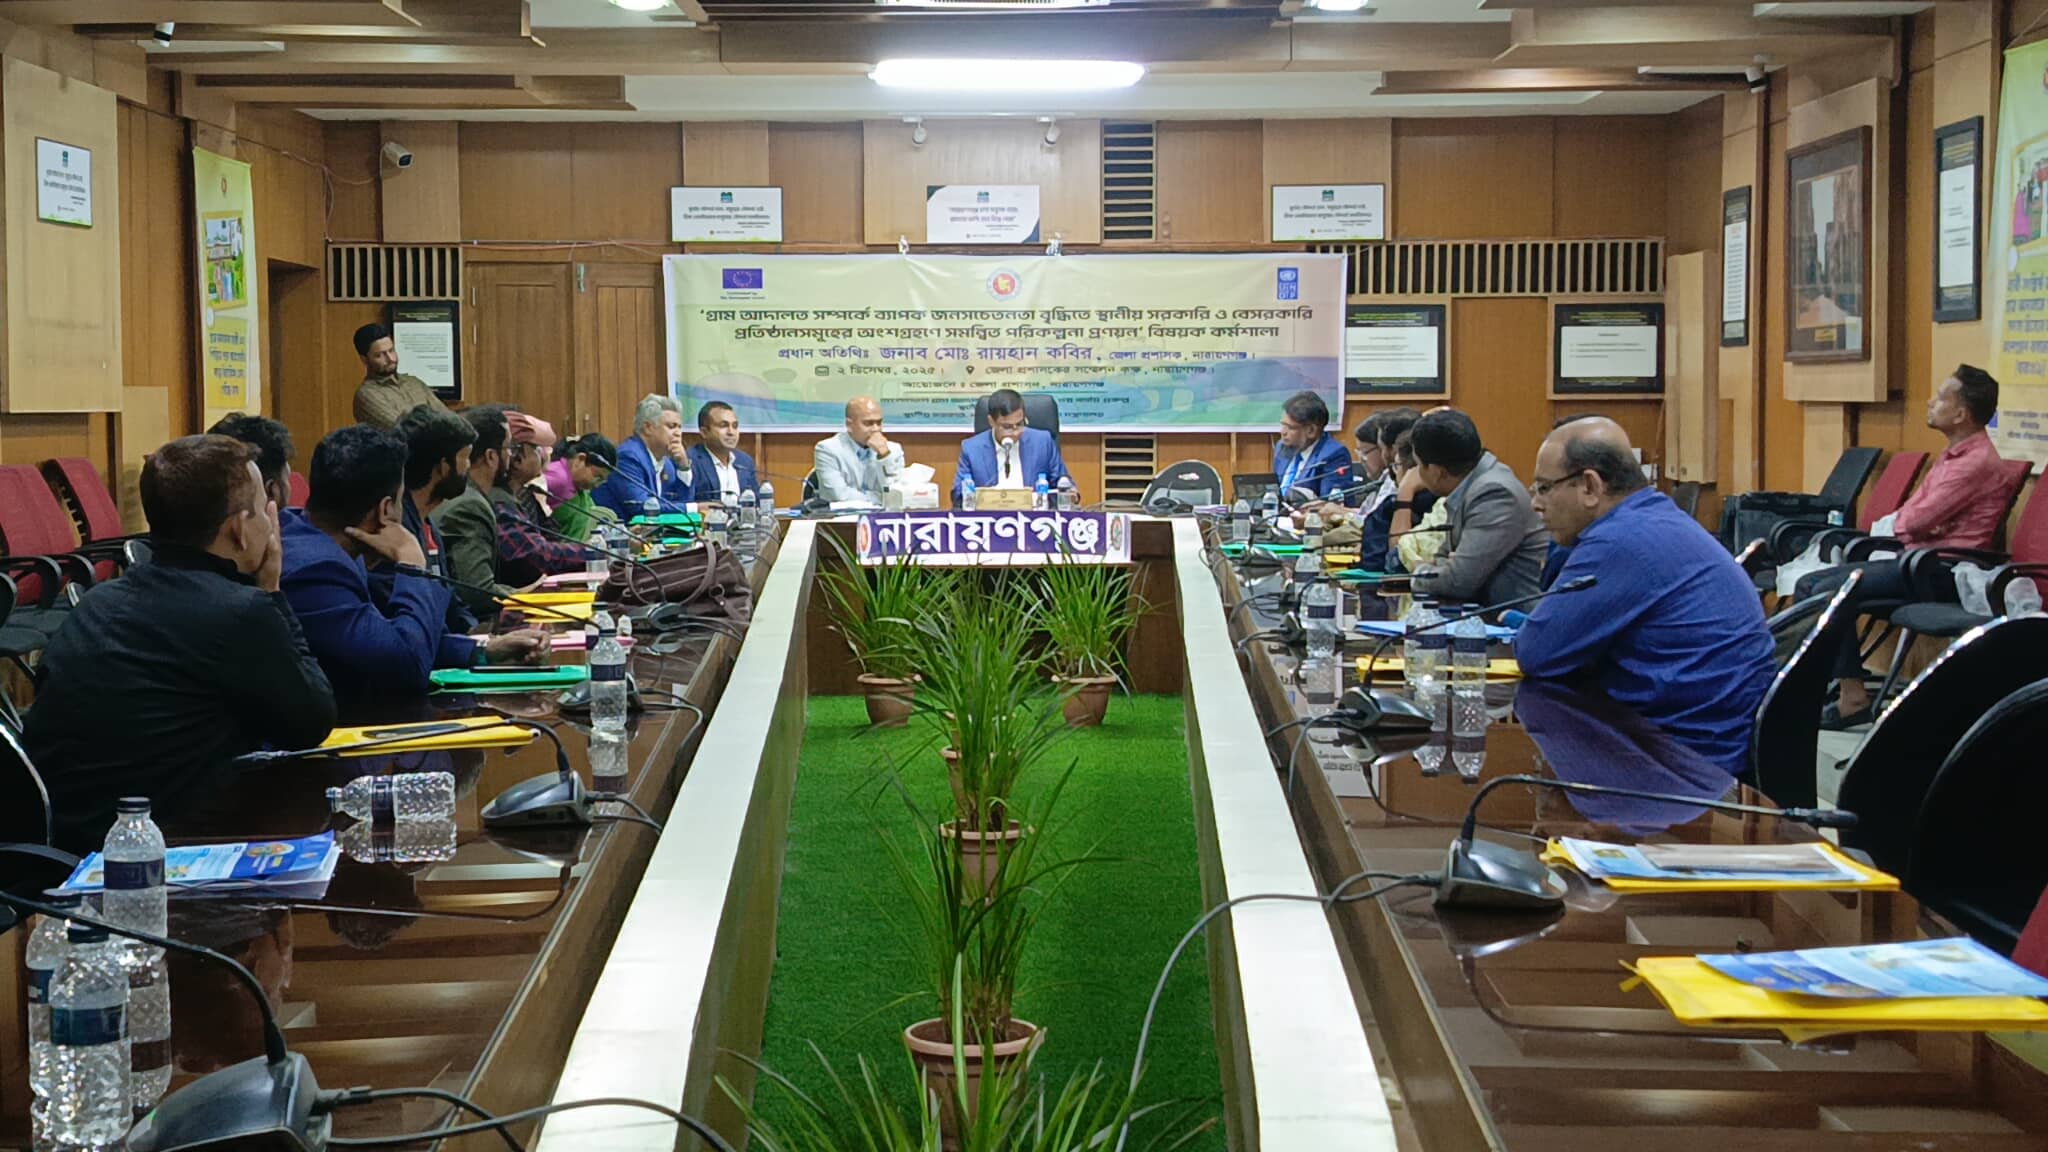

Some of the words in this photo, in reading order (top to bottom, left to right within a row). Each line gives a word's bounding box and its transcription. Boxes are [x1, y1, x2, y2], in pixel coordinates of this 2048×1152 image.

[740, 310, 809, 321] আদালত
[812, 306, 871, 321] সম্পর্কে
[874, 309, 927, 321] ব্যাপক
[931, 309, 1035, 321] জনসচেতনতা
[1039, 306, 1091, 324] বৃদ্ধিতে
[1096, 306, 1143, 321] স্থানীয়
[1149, 306, 1210, 321] সরকারি
[1214, 309, 1228, 320] ও
[1232, 305, 1313, 321] বেসরকারি
[734, 324, 853, 342] প্রতিষ্ঠানসমূহের
[857, 327, 941, 339] অংশগ্রহণে
[945, 324, 1001, 340] সমন্বিত
[1005, 323, 1084, 339] পরিকল্পনা
[1148, 323, 1206, 338] বিষয়ক
[1210, 323, 1279, 337] কর্মশালা
[778, 348, 813, 359] প্রধান
[879, 347, 929, 360] জনাব
[935, 347, 969, 360] মোঃ
[976, 347, 1039, 361] রায়হান
[1109, 351, 1136, 360] জেলা
[838, 366, 845, 375] ২
[874, 511, 1099, 553] নারায়ণগঞ্জ
